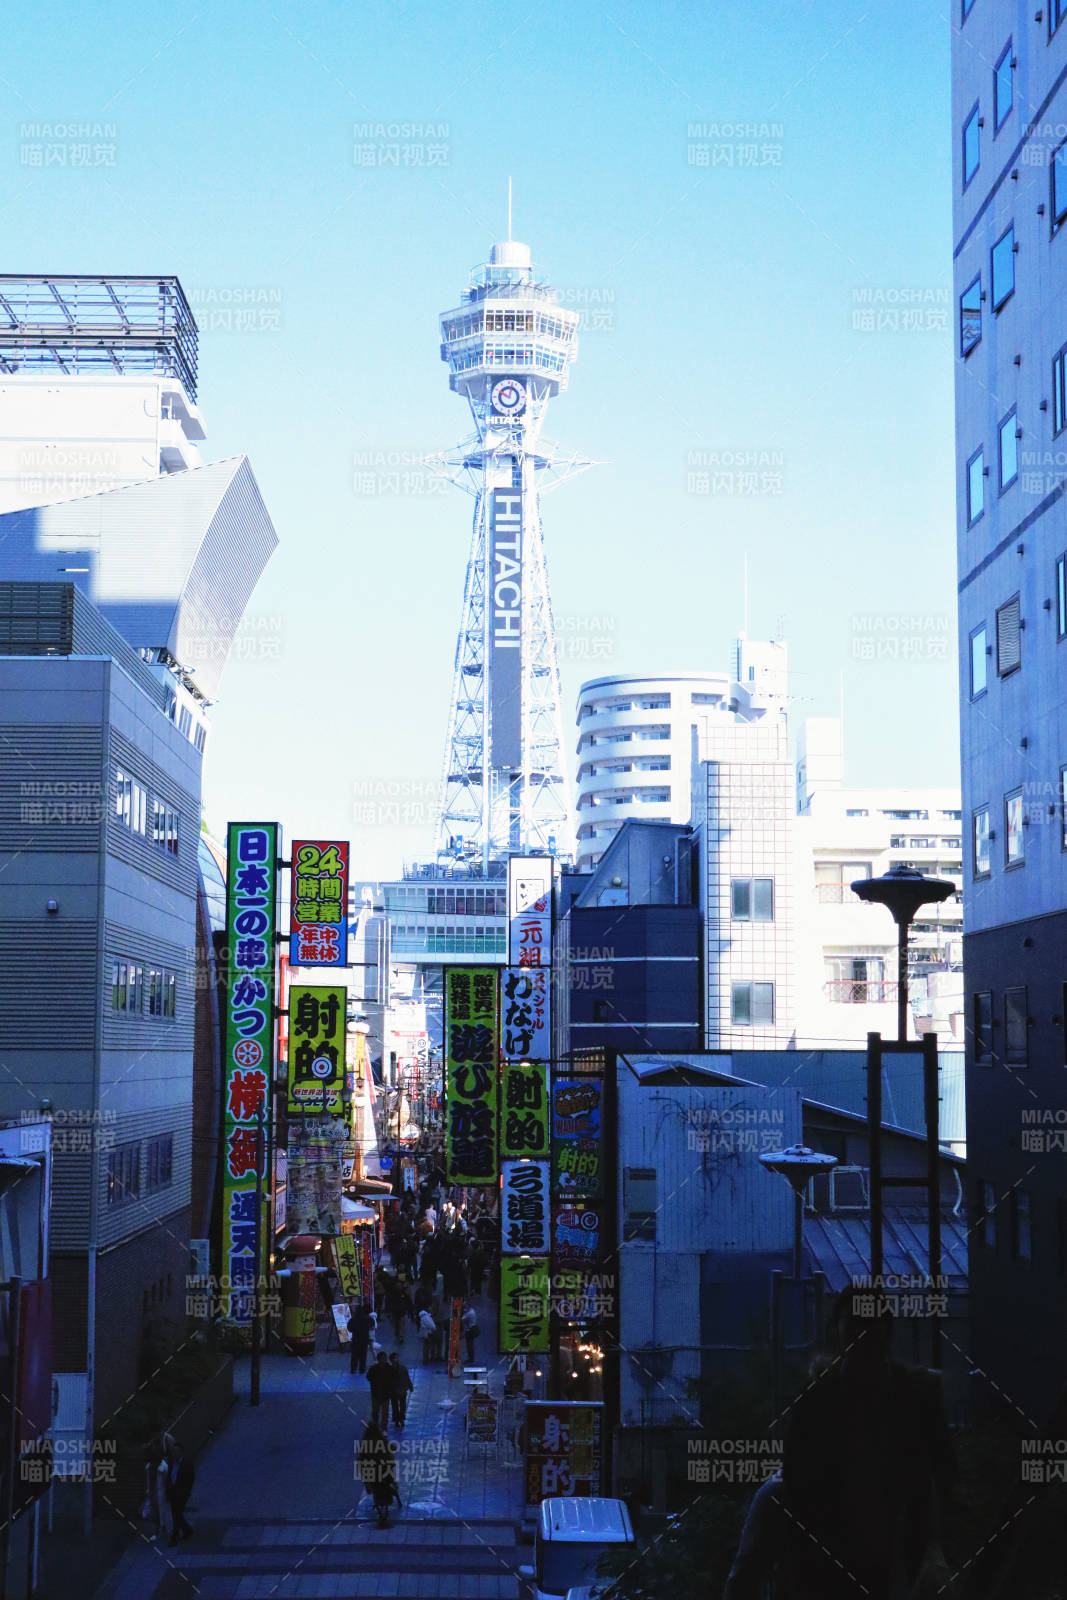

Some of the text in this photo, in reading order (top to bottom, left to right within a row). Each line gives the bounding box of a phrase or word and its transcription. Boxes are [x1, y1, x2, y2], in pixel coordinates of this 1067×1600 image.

[494, 496, 521, 648] HITACHI
[296, 846, 343, 876] 24
[296, 877, 342, 900] 時間
[232, 831, 269, 1037] 日本一の串かつ
[294, 900, 342, 924] 営業
[298, 927, 339, 945] 年中
[519, 920, 543, 968] 元祖
[298, 944, 339, 963] 無休
[294, 992, 341, 1086] 射的
[504, 973, 534, 1055] わなげ
[531, 972, 546, 1030] スペシャル
[227, 1071, 267, 1178] 横綱
[449, 1022, 495, 1179] 遊び放題
[505, 1069, 545, 1151] 射的
[507, 1165, 545, 1249] 弓道場
